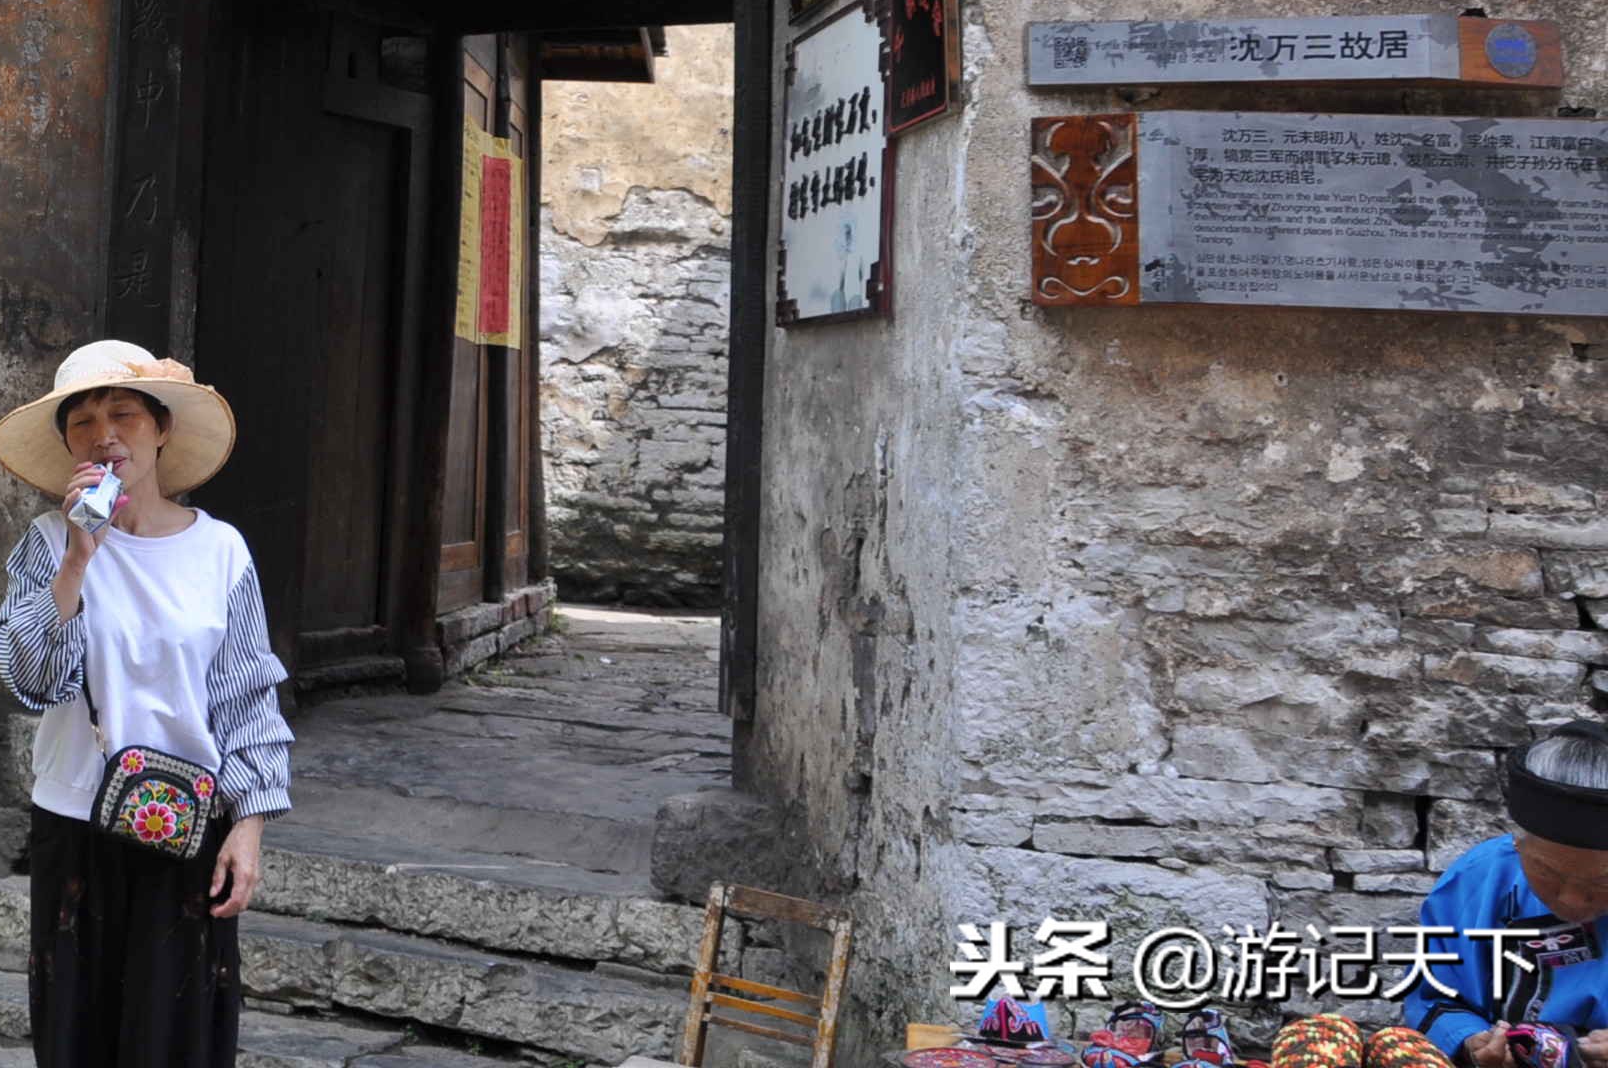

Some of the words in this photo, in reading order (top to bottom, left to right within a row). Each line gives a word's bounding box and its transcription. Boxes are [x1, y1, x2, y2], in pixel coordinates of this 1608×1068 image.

[1229, 29, 1408, 63] 沈万三故居
